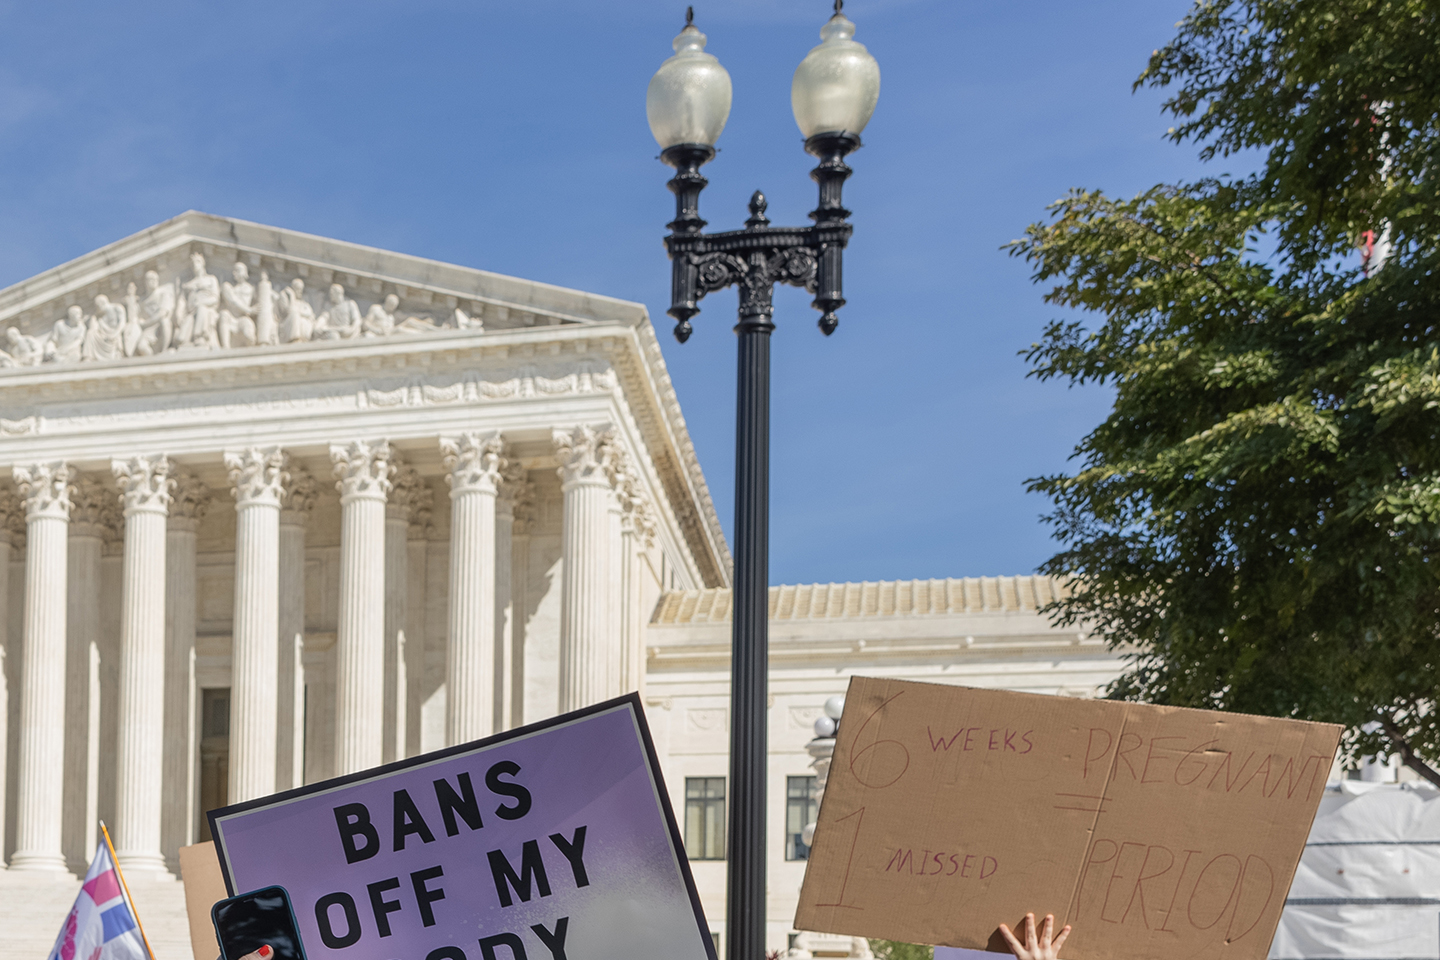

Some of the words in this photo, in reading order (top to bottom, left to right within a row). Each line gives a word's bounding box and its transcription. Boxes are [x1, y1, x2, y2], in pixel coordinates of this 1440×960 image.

[849, 690, 909, 789] 6
[927, 726, 1035, 755] WEEKS
[1082, 727, 1333, 802] PREGNANT
[332, 760, 533, 865] BANS
[314, 864, 446, 950] OFF
[486, 825, 592, 908] MY
[885, 847, 998, 880] MISSED
[1073, 838, 1274, 943] PERIOD
